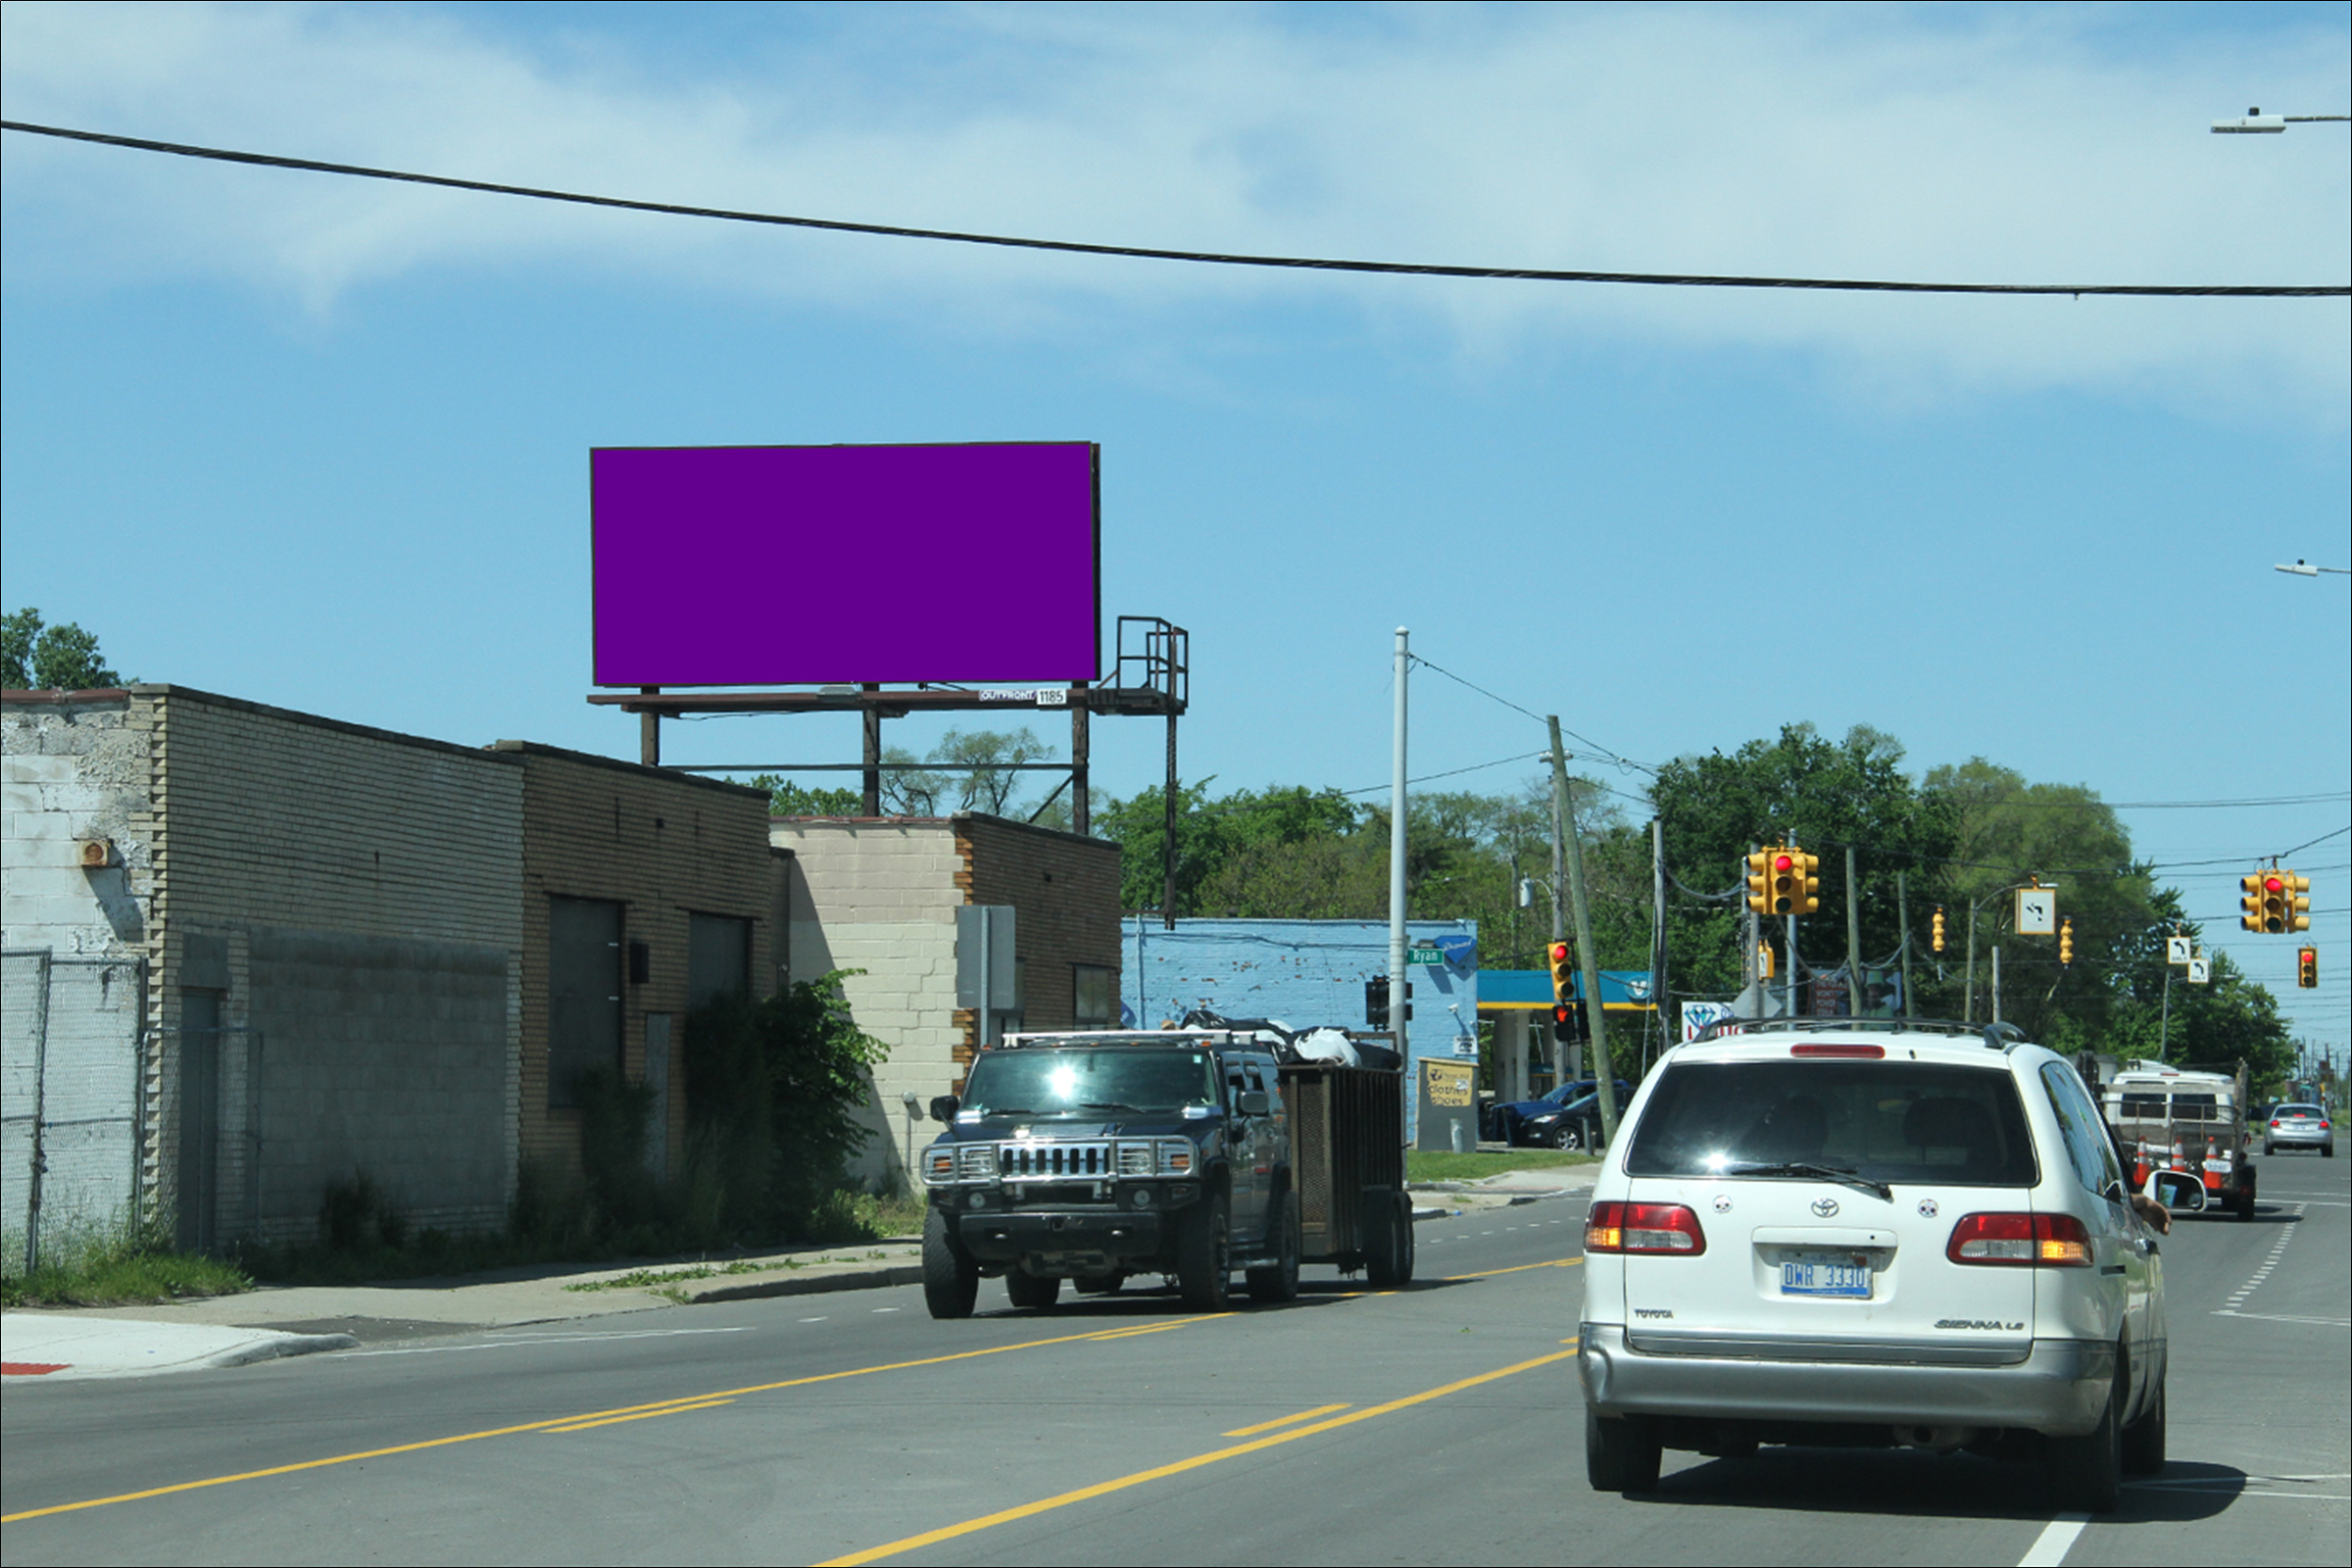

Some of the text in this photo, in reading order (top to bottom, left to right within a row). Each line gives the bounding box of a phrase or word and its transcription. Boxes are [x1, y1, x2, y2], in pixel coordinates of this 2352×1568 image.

[1040, 690, 1064, 703] 1185
[1413, 950, 1438, 964] Ryan
[1785, 1263, 1814, 1286] DWR
[1634, 1308, 1674, 1319] TOYOTA
[1934, 1319, 2003, 1330] SIENNA
